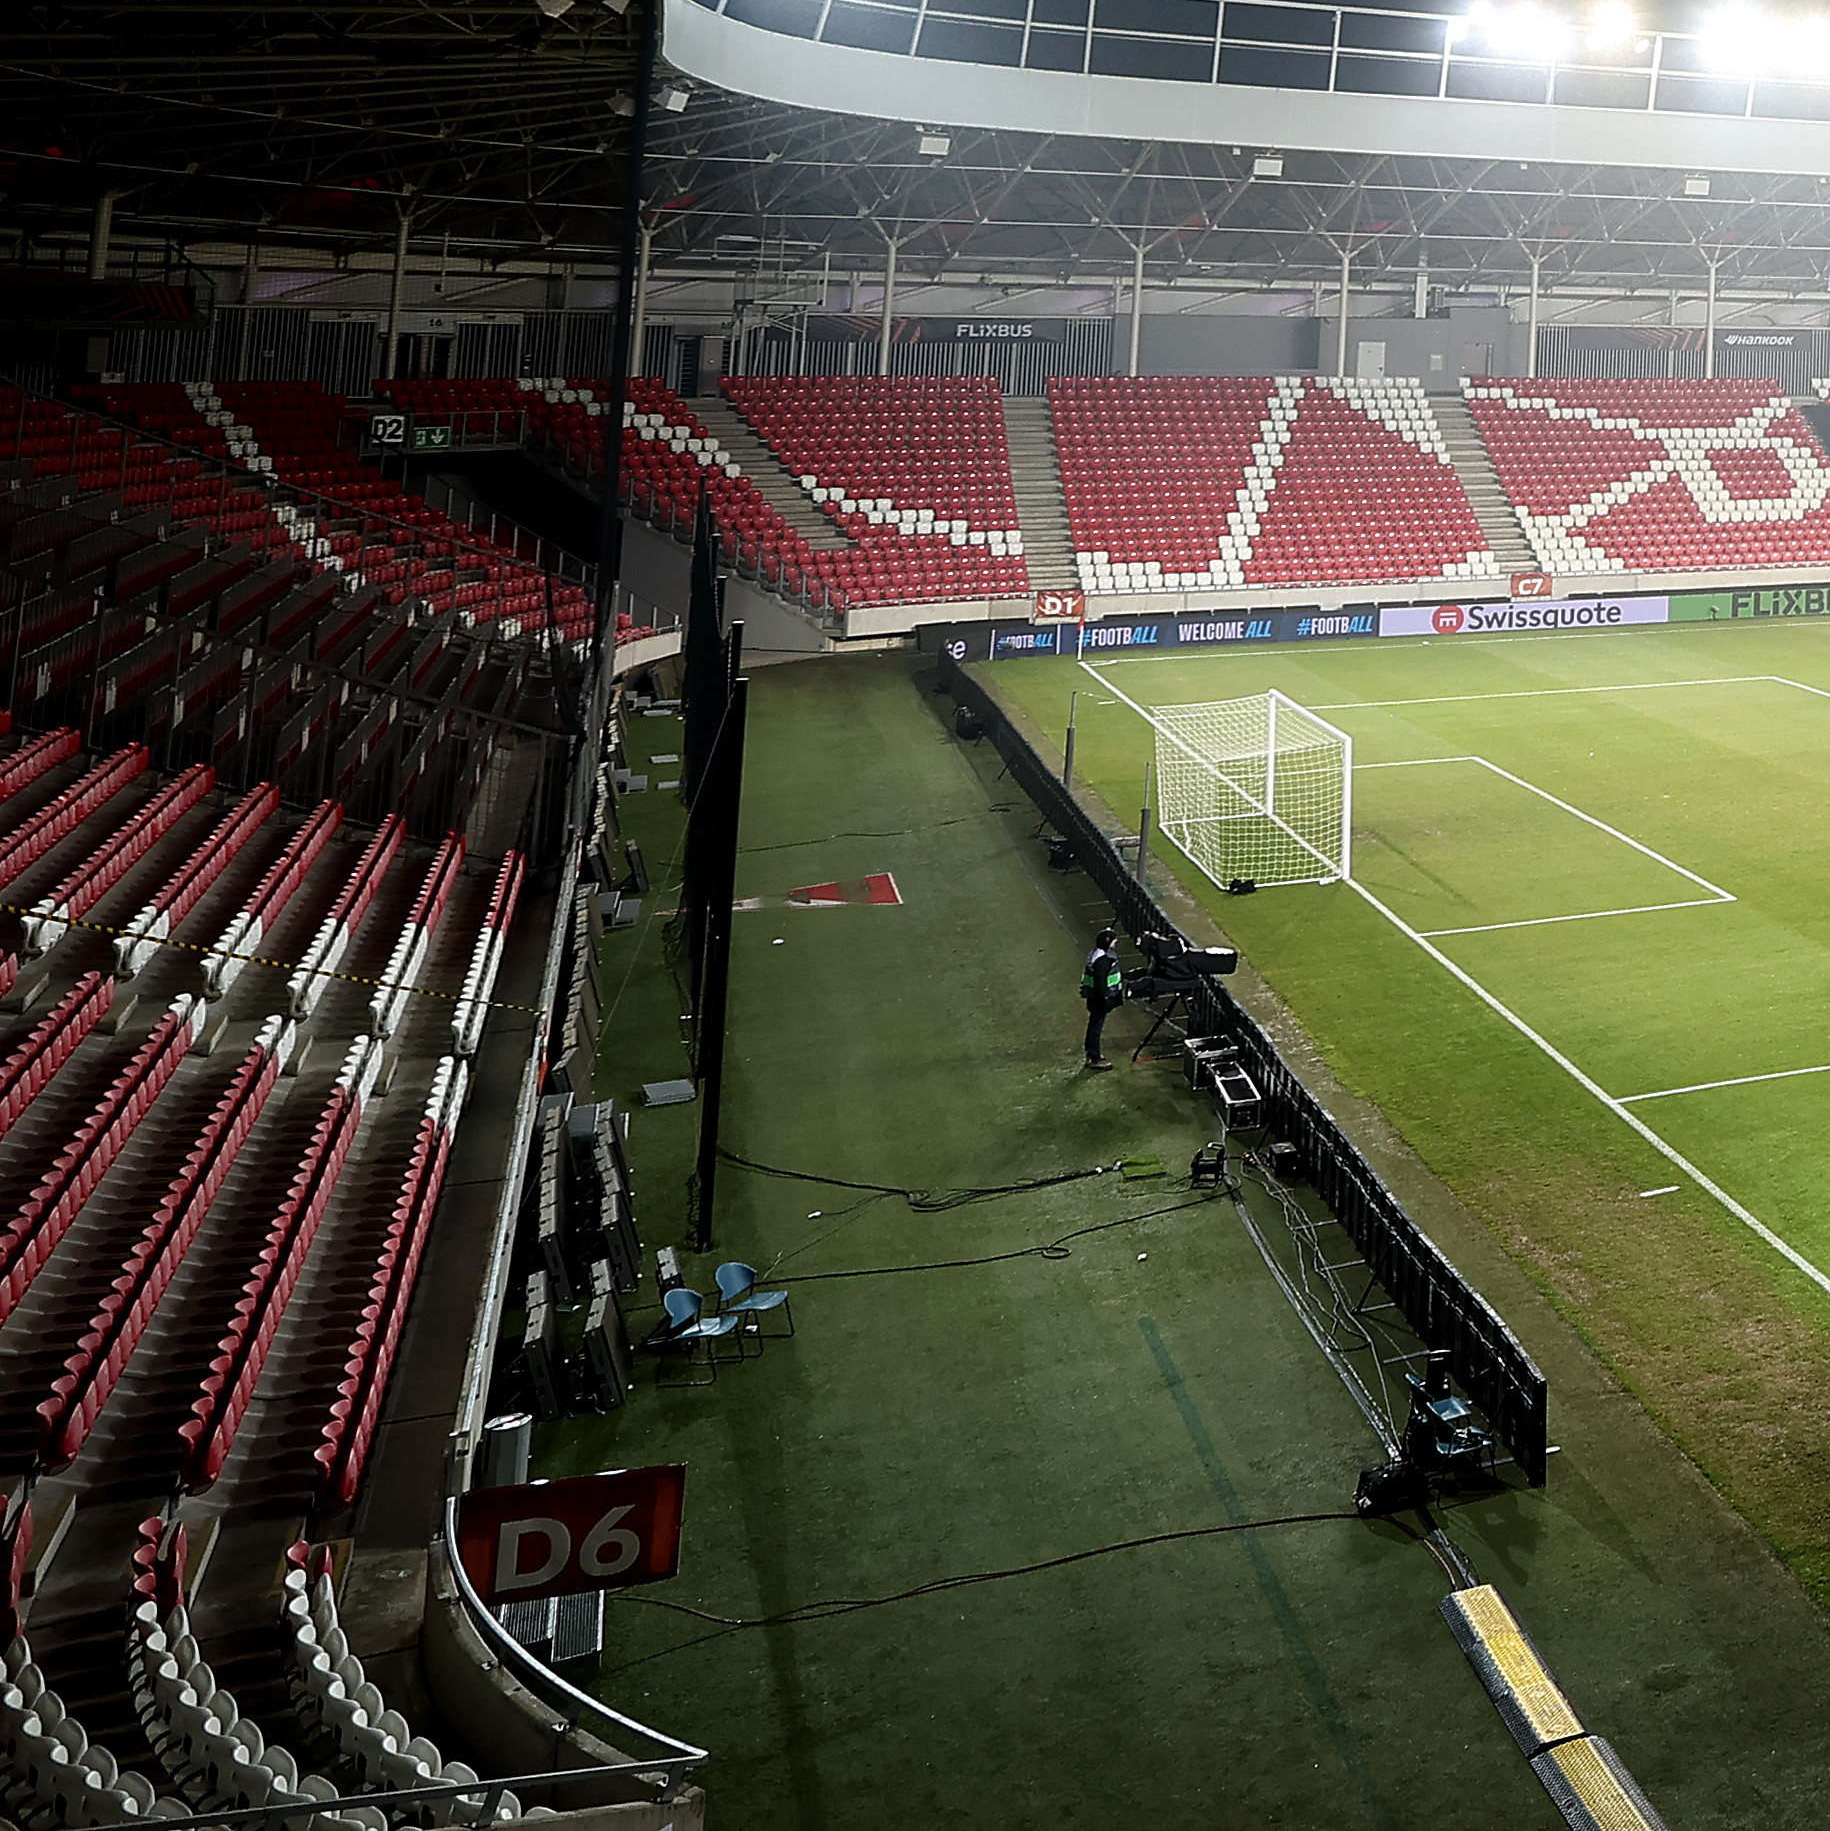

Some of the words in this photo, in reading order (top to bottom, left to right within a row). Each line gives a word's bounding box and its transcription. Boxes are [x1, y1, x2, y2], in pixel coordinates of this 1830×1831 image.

[373, 419, 402, 440] D2
[1518, 578, 1544, 595] C7
[1045, 597, 1075, 614] D1
[1468, 602, 1622, 630] Swissquote
[1076, 625, 1157, 647] #FOOTBALL
[1178, 622, 1244, 641] WELCOME
[1245, 620, 1272, 638] ALL
[1297, 615, 1373, 636] #FOOTBALL
[494, 1504, 640, 1593] D6
